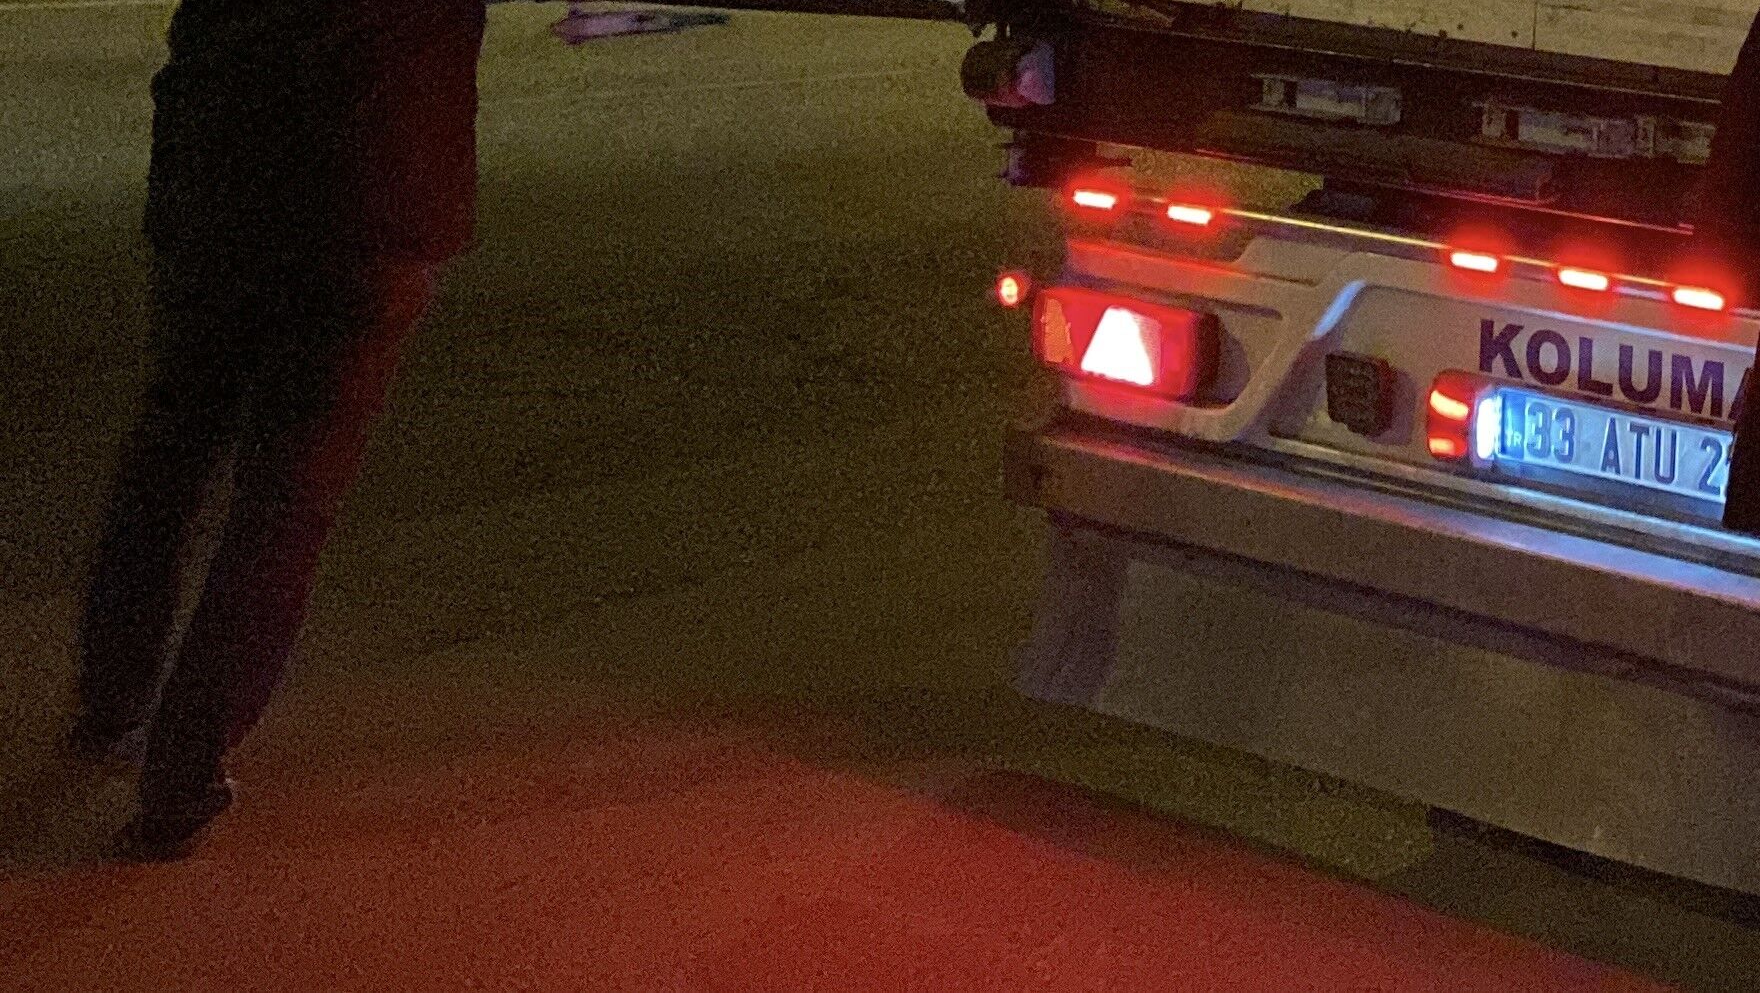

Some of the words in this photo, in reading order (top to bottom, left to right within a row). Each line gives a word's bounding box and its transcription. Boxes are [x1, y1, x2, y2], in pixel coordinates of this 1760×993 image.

[1525, 399, 1576, 460] 33
[1600, 416, 1678, 485] ATU
[1699, 435, 1732, 496] 2
